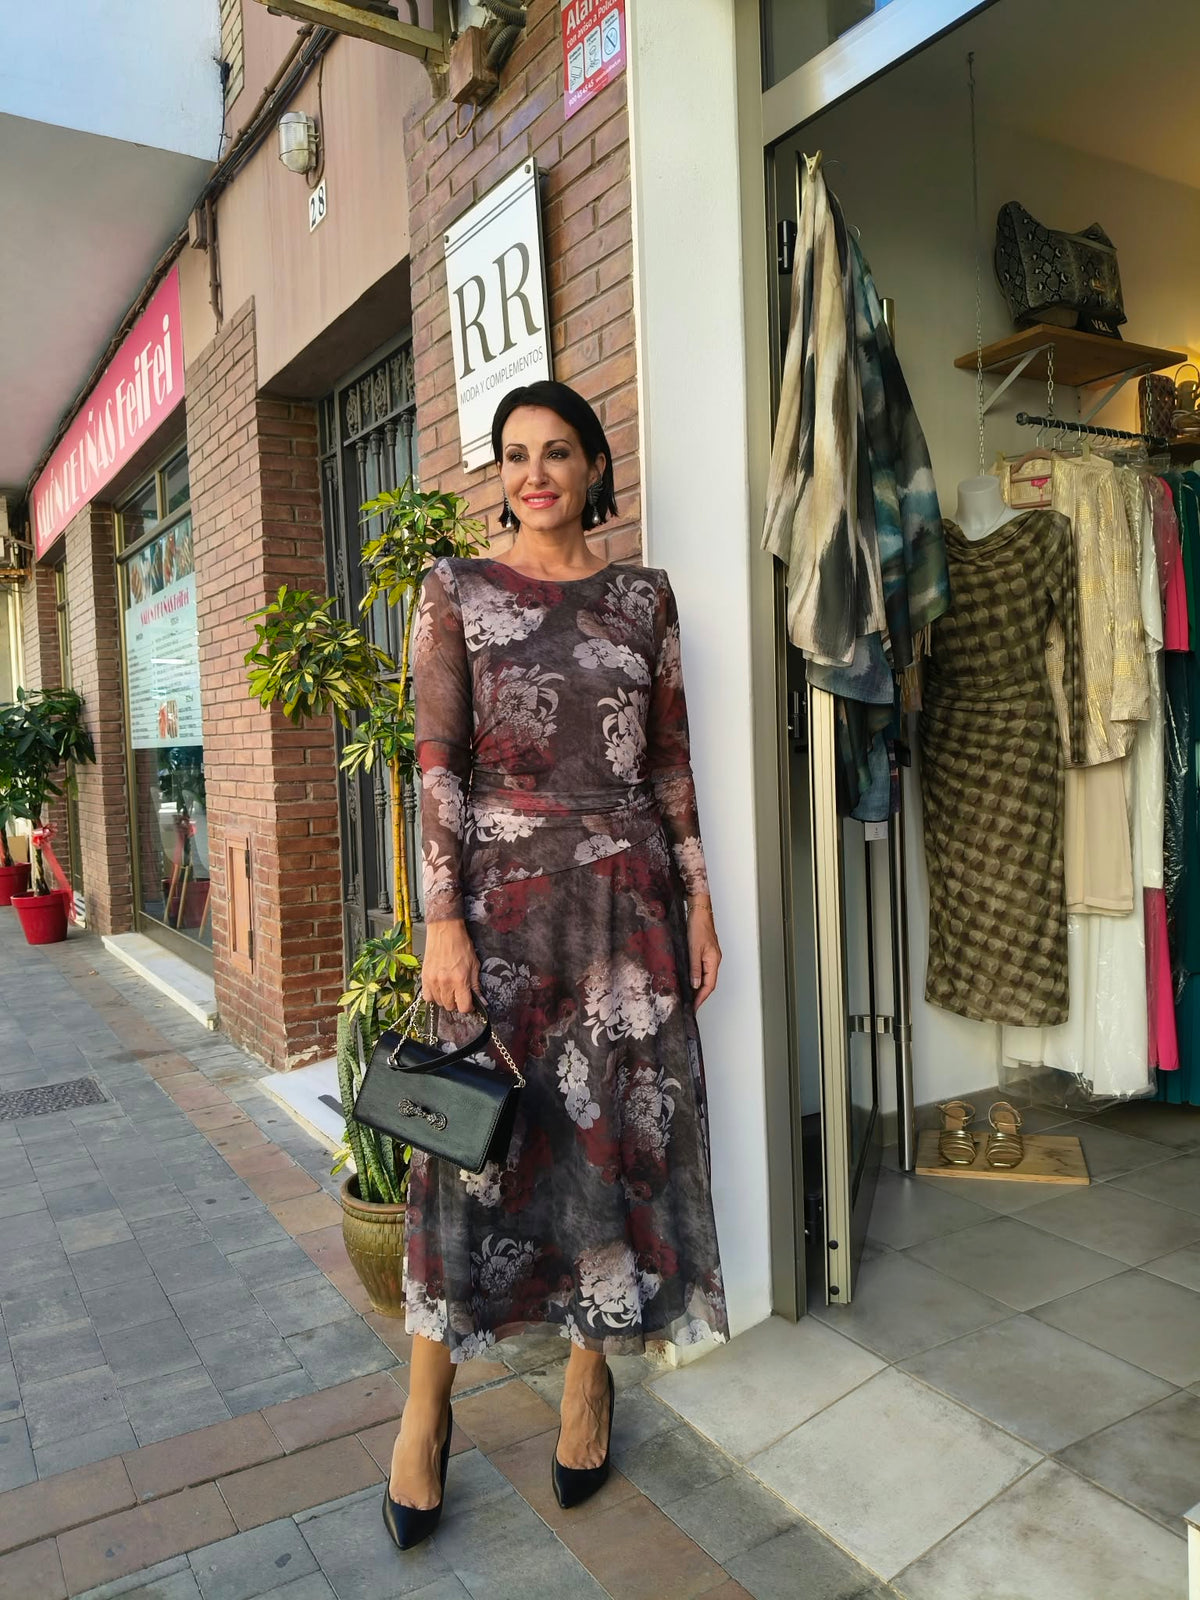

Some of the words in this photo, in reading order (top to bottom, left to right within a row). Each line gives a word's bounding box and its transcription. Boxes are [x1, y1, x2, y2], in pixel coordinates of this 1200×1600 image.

[567, 0, 602, 35] Alar
[567, 35, 578, 49] con
[577, 19, 593, 39] aviso
[311, 186, 324, 227] 28
[452, 242, 542, 380] RR
[460, 386, 480, 405] MODA
[480, 380, 486, 393] Y
[486, 346, 543, 390] COMPLEMENTOS
[36, 467, 64, 547] SALÓN
[63, 447, 80, 513] DE
[79, 398, 115, 492] UÑAS
[115, 314, 173, 450] FeiFei
